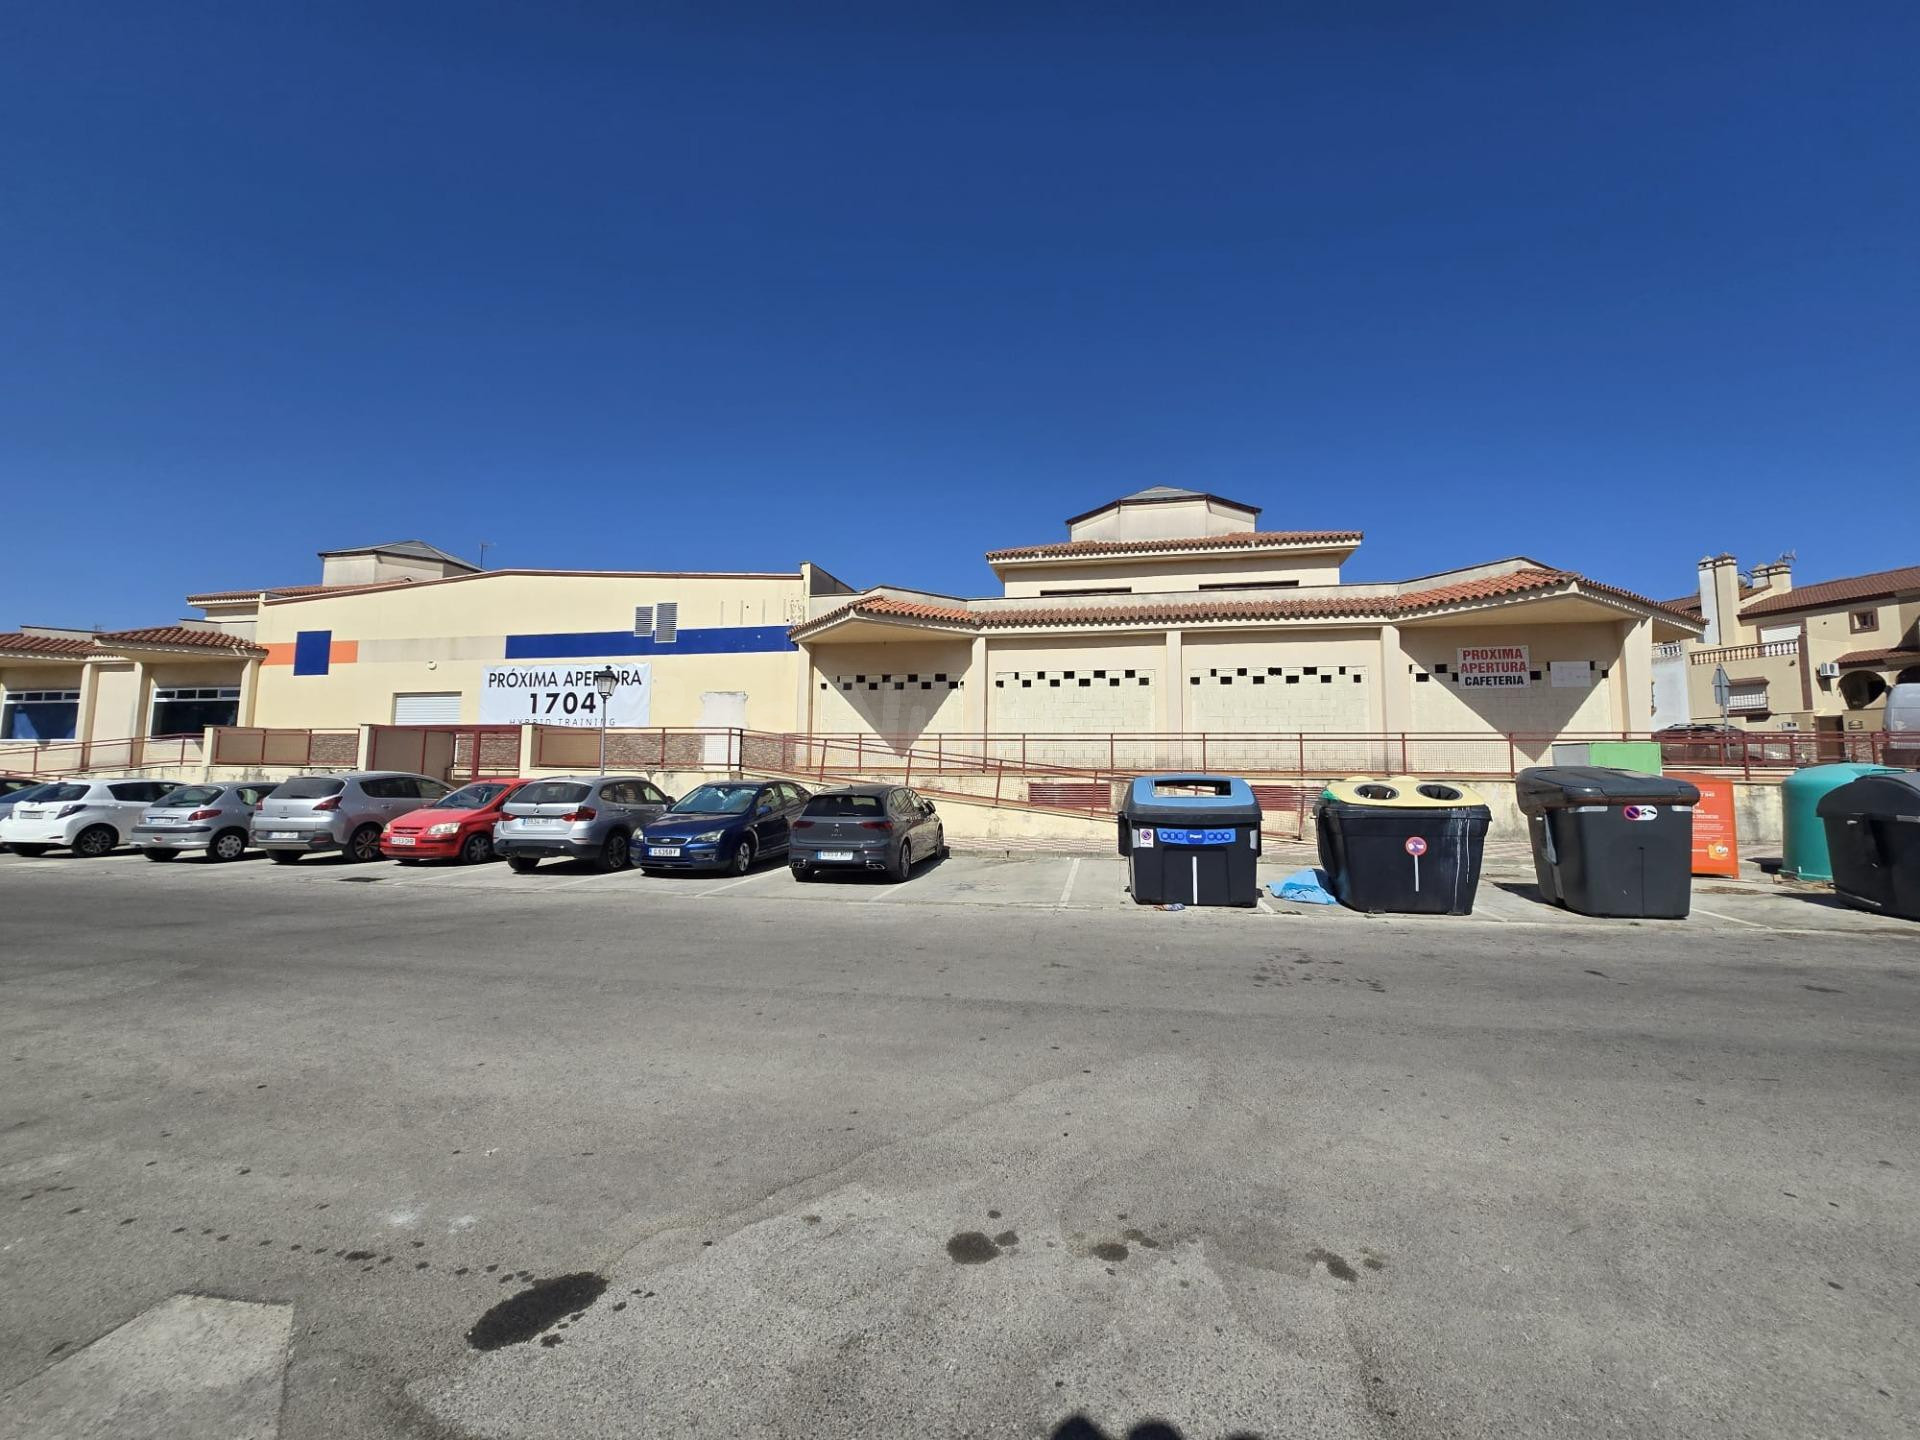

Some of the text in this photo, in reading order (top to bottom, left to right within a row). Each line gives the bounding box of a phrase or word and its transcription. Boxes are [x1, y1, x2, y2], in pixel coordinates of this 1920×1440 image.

[1462, 648, 1523, 660] PROXIMA
[1460, 661, 1527, 674] APERTURA
[488, 668, 642, 688] PRÓXIMA APERRA
[1464, 675, 1524, 686] CAFETERIA
[530, 692, 597, 714] 1704
